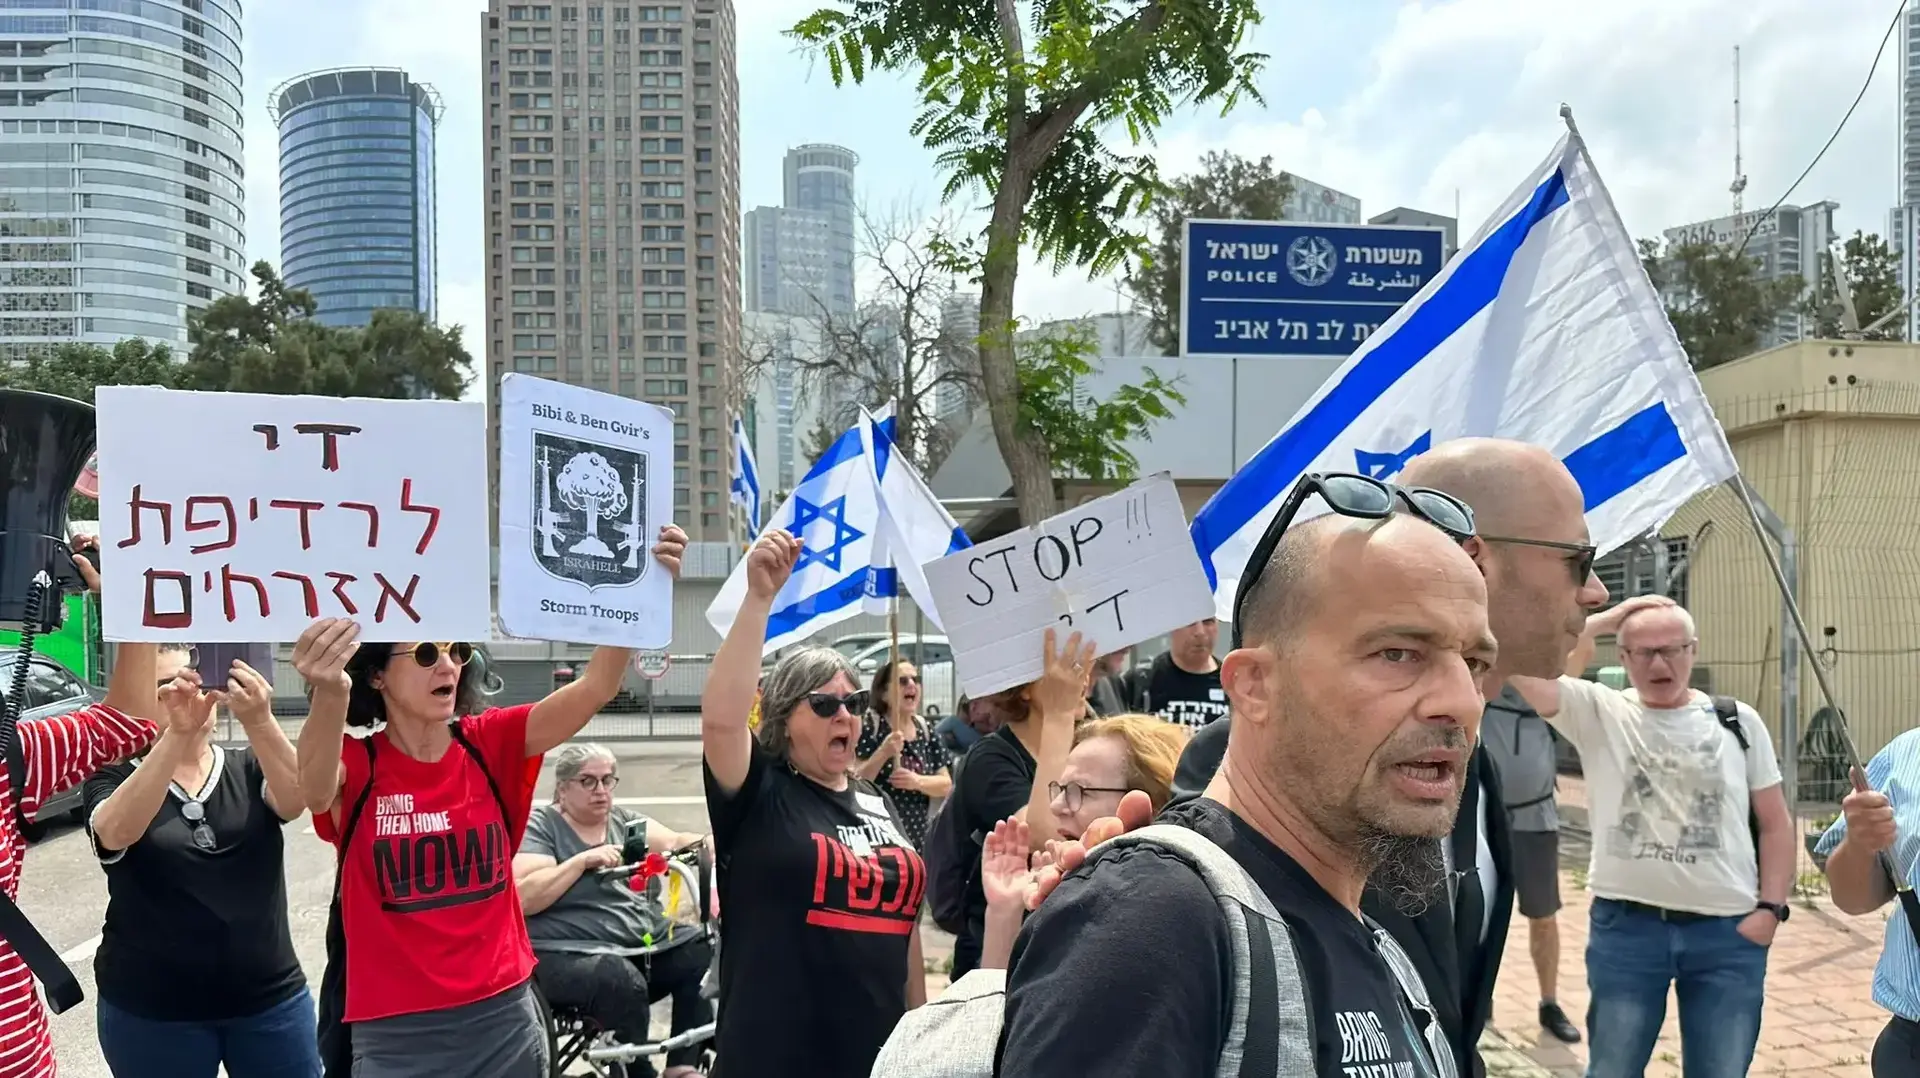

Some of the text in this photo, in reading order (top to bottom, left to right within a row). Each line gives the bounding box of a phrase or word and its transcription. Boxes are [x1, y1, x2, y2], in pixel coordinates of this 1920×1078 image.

[1206, 239, 1422, 266] משטרת ישראל
[1207, 270, 1278, 283] POLICE
[1348, 272, 1420, 292] الشرطة
[1214, 319, 1270, 340] אביב
[1277, 317, 1308, 341] תל
[1316, 318, 1345, 341] לב
[531, 403, 650, 440] Bibi & Ben Gvir's
[252, 423, 362, 472] די
[117, 477, 441, 556] לרדיפת
[563, 555, 622, 574] ISRAHELL
[966, 516, 1103, 607] STOP
[142, 562, 423, 629] אזרחים
[540, 598, 640, 623] Storm Troops
[1059, 589, 1129, 633] די
[1167, 700, 1229, 715] אחרת
[376, 794, 414, 815] BRING
[375, 810, 453, 837] THEM HOME
[372, 820, 504, 899] NOW!
[1335, 1011, 1391, 1063] BRING
